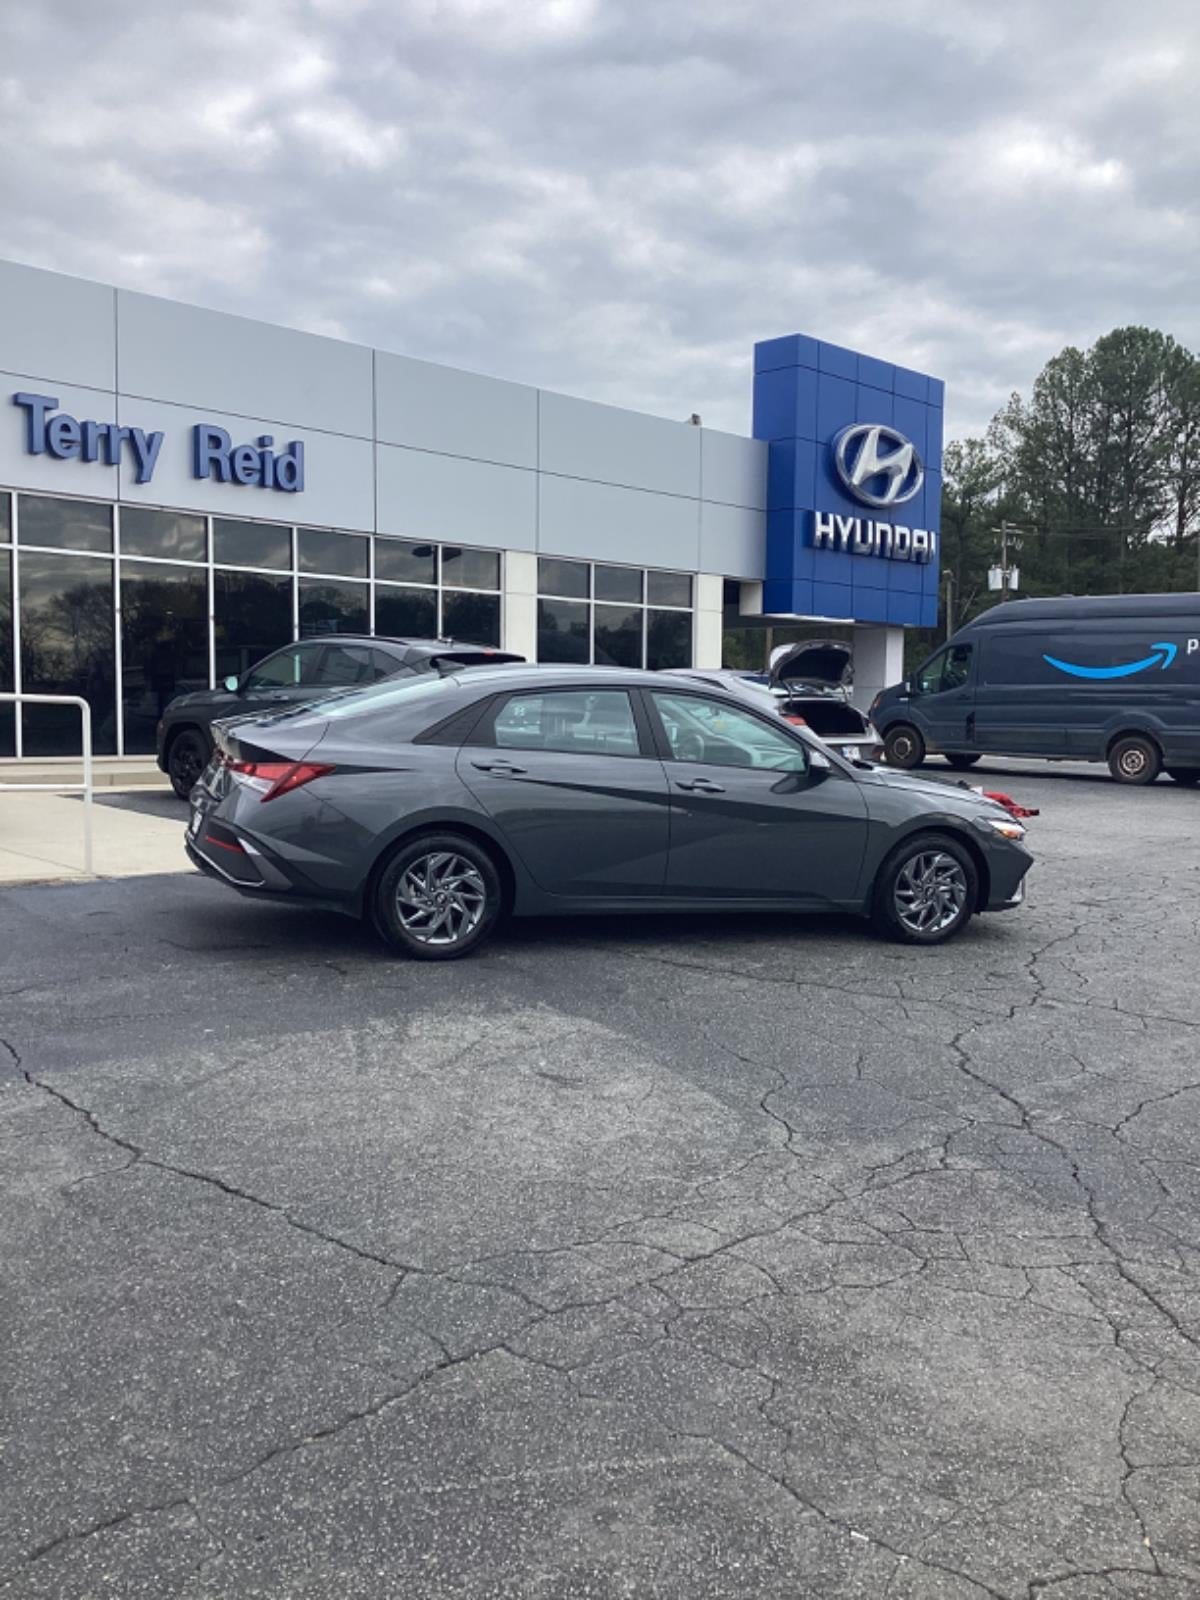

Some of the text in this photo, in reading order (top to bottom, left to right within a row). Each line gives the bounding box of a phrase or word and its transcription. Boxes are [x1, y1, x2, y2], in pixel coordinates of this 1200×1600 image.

[13, 392, 305, 492] Terry Reid
[814, 511, 936, 562] HYUNDAI
